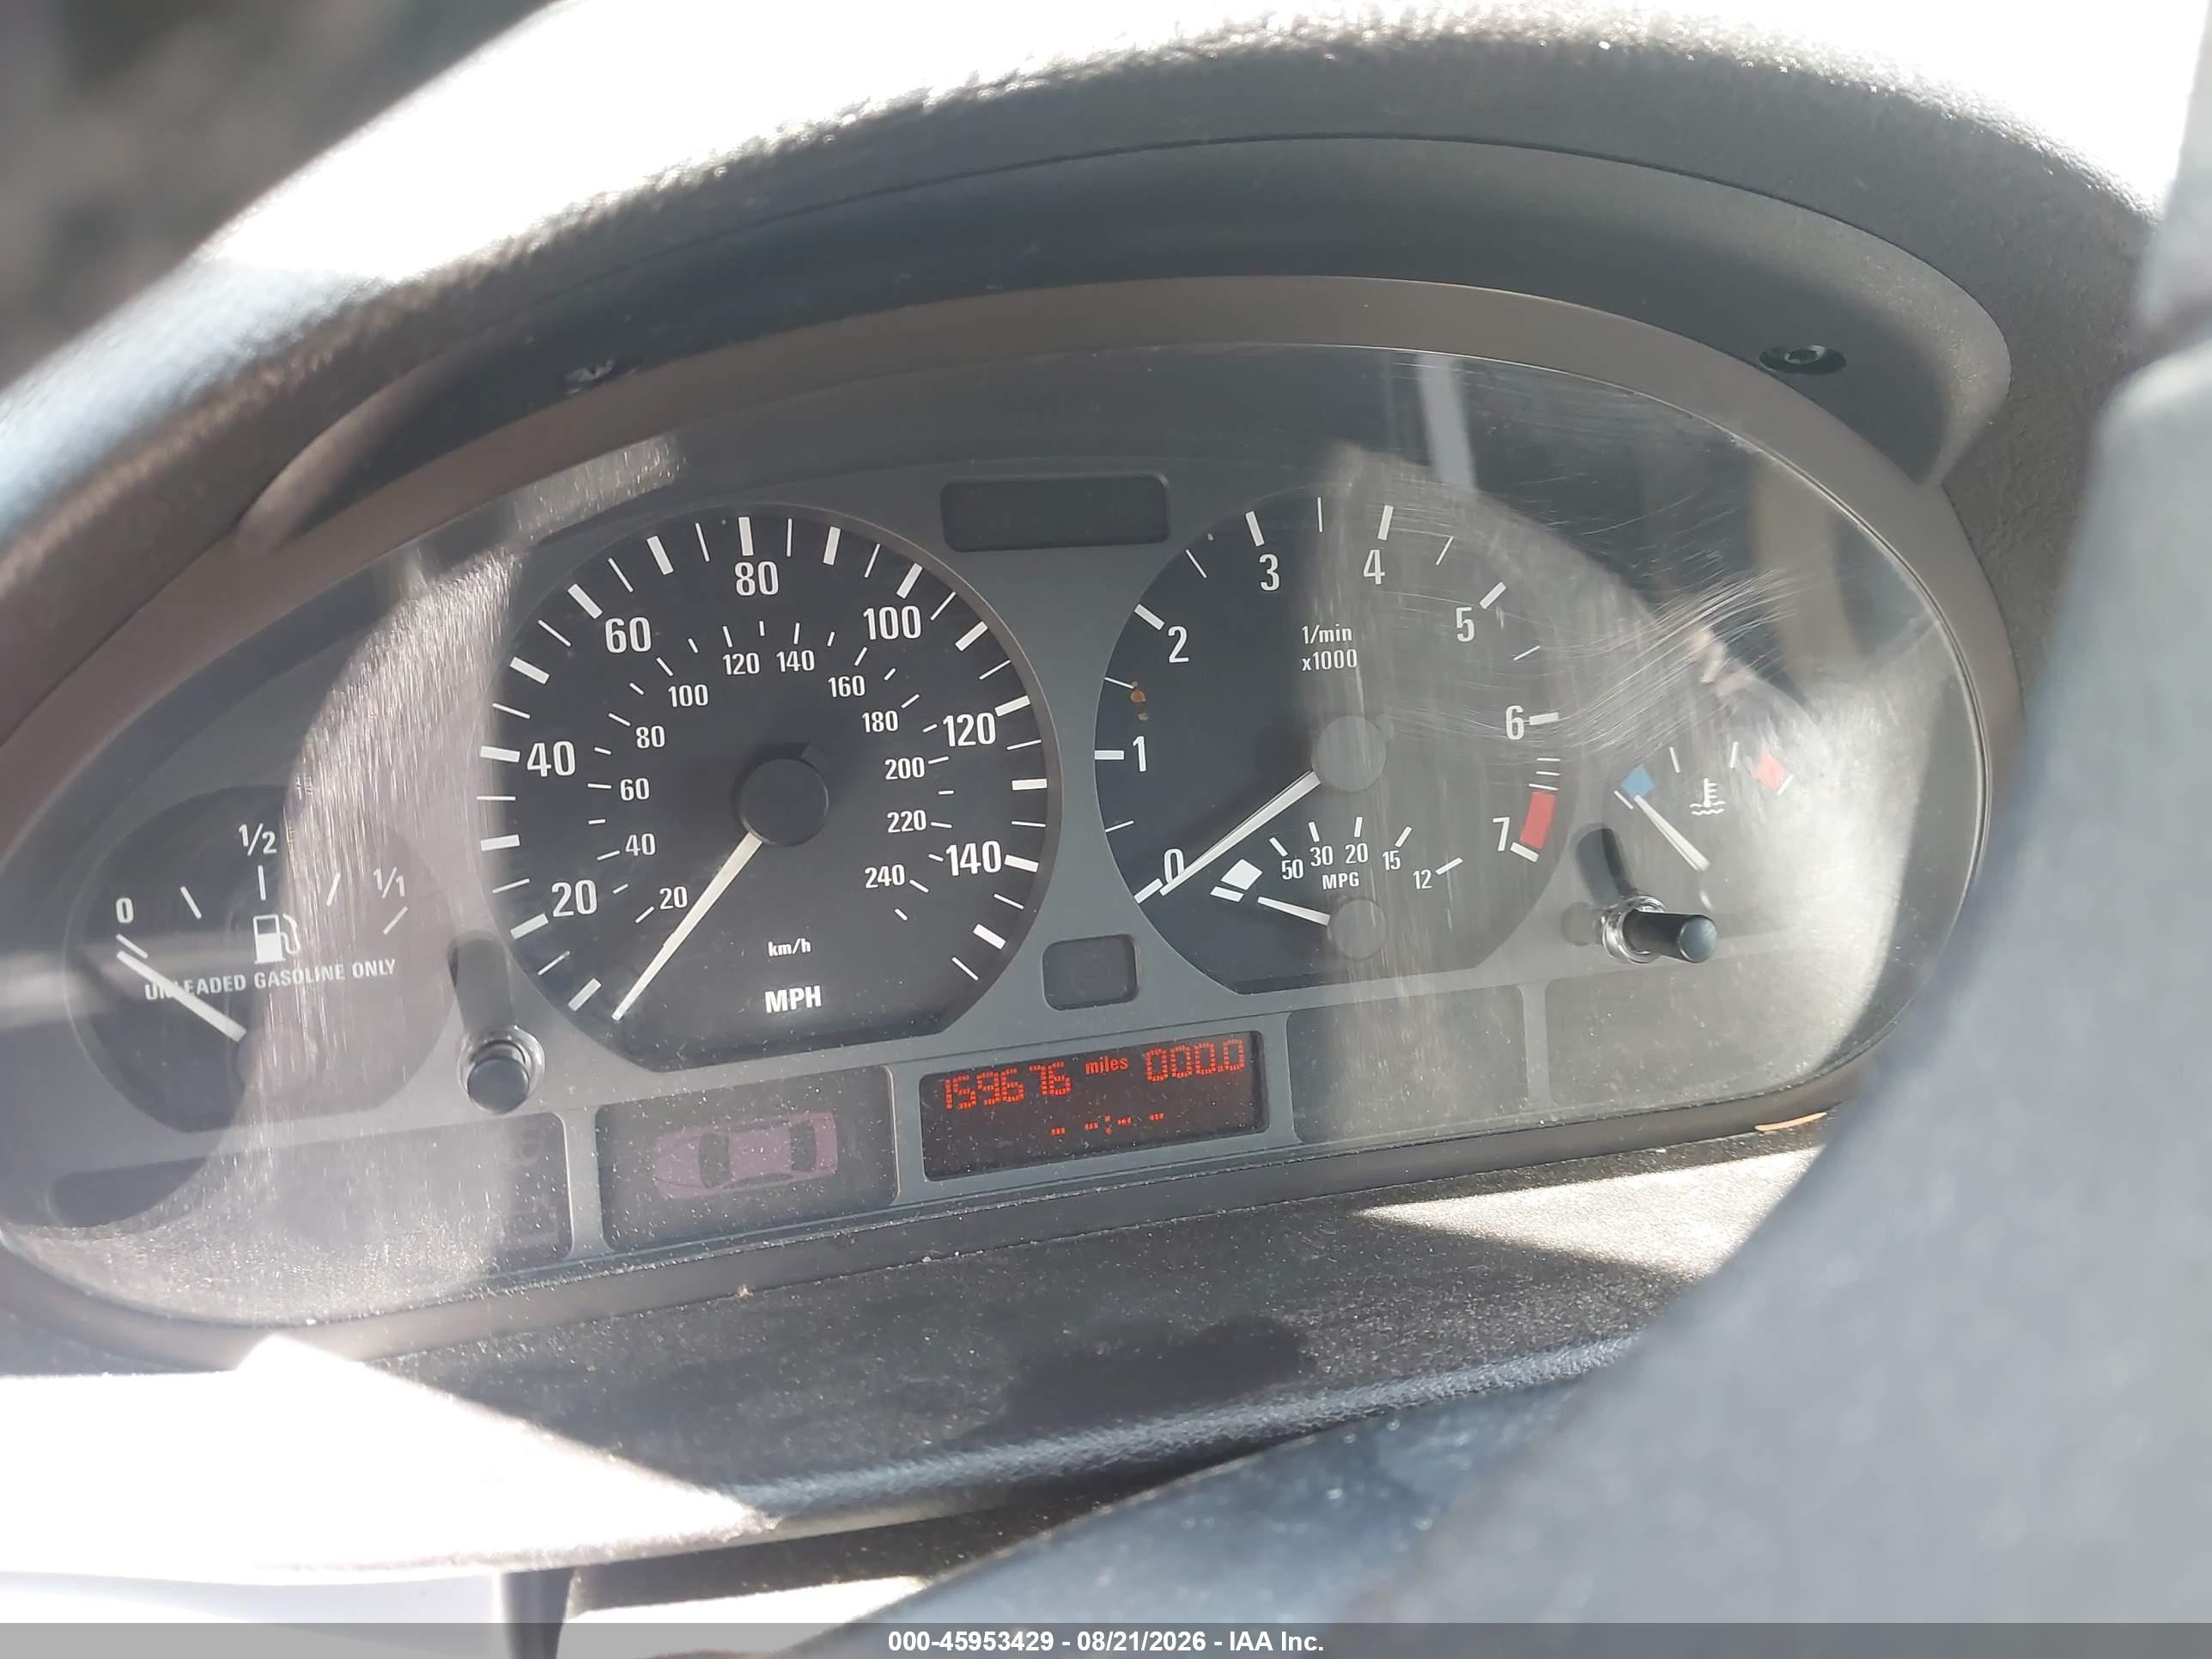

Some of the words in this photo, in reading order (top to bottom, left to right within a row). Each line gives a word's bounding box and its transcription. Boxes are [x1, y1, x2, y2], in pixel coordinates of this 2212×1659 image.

[1259, 554, 1280, 591] 3
[1364, 550, 1385, 584] 4
[735, 562, 779, 596] 80
[863, 606, 921, 640] 100
[1302, 624, 1352, 644] 1/min
[1455, 606, 1474, 641] 5
[605, 617, 652, 653] 60
[1167, 626, 1189, 663] 2
[723, 653, 759, 675] 120
[776, 650, 815, 672] 140
[1302, 649, 1357, 671] x1000
[667, 684, 708, 708] 100
[828, 676, 866, 697] 160
[862, 711, 898, 733] 180
[943, 713, 995, 746] 120
[1505, 705, 1524, 739] 6
[635, 726, 665, 748] 80
[526, 741, 575, 776] 40
[1133, 736, 1146, 771] 1
[884, 757, 925, 780] 200
[620, 778, 650, 800] 60
[886, 809, 927, 832] 220
[625, 833, 655, 855] 40
[1492, 817, 1510, 851] 7
[945, 841, 1002, 876] 140
[1310, 846, 1334, 866] 30
[1345, 843, 1368, 862] 20
[1382, 850, 1401, 870] 15
[865, 865, 905, 888] 240
[1164, 848, 1185, 885] 0
[1281, 860, 1304, 879] 50
[1322, 872, 1359, 890] MPG
[1413, 870, 1432, 890] 12
[551, 880, 597, 916] 20
[659, 886, 687, 908] 20
[117, 897, 134, 924] 0
[768, 938, 811, 956] km/h
[254, 963, 344, 988] GASOLINE
[352, 959, 395, 977] ONLY
[765, 986, 822, 1012] MPH
[945, 1061, 1072, 1109] 159676
[1085, 1056, 1128, 1075] miles
[1146, 1038, 1246, 1081] 000.0
